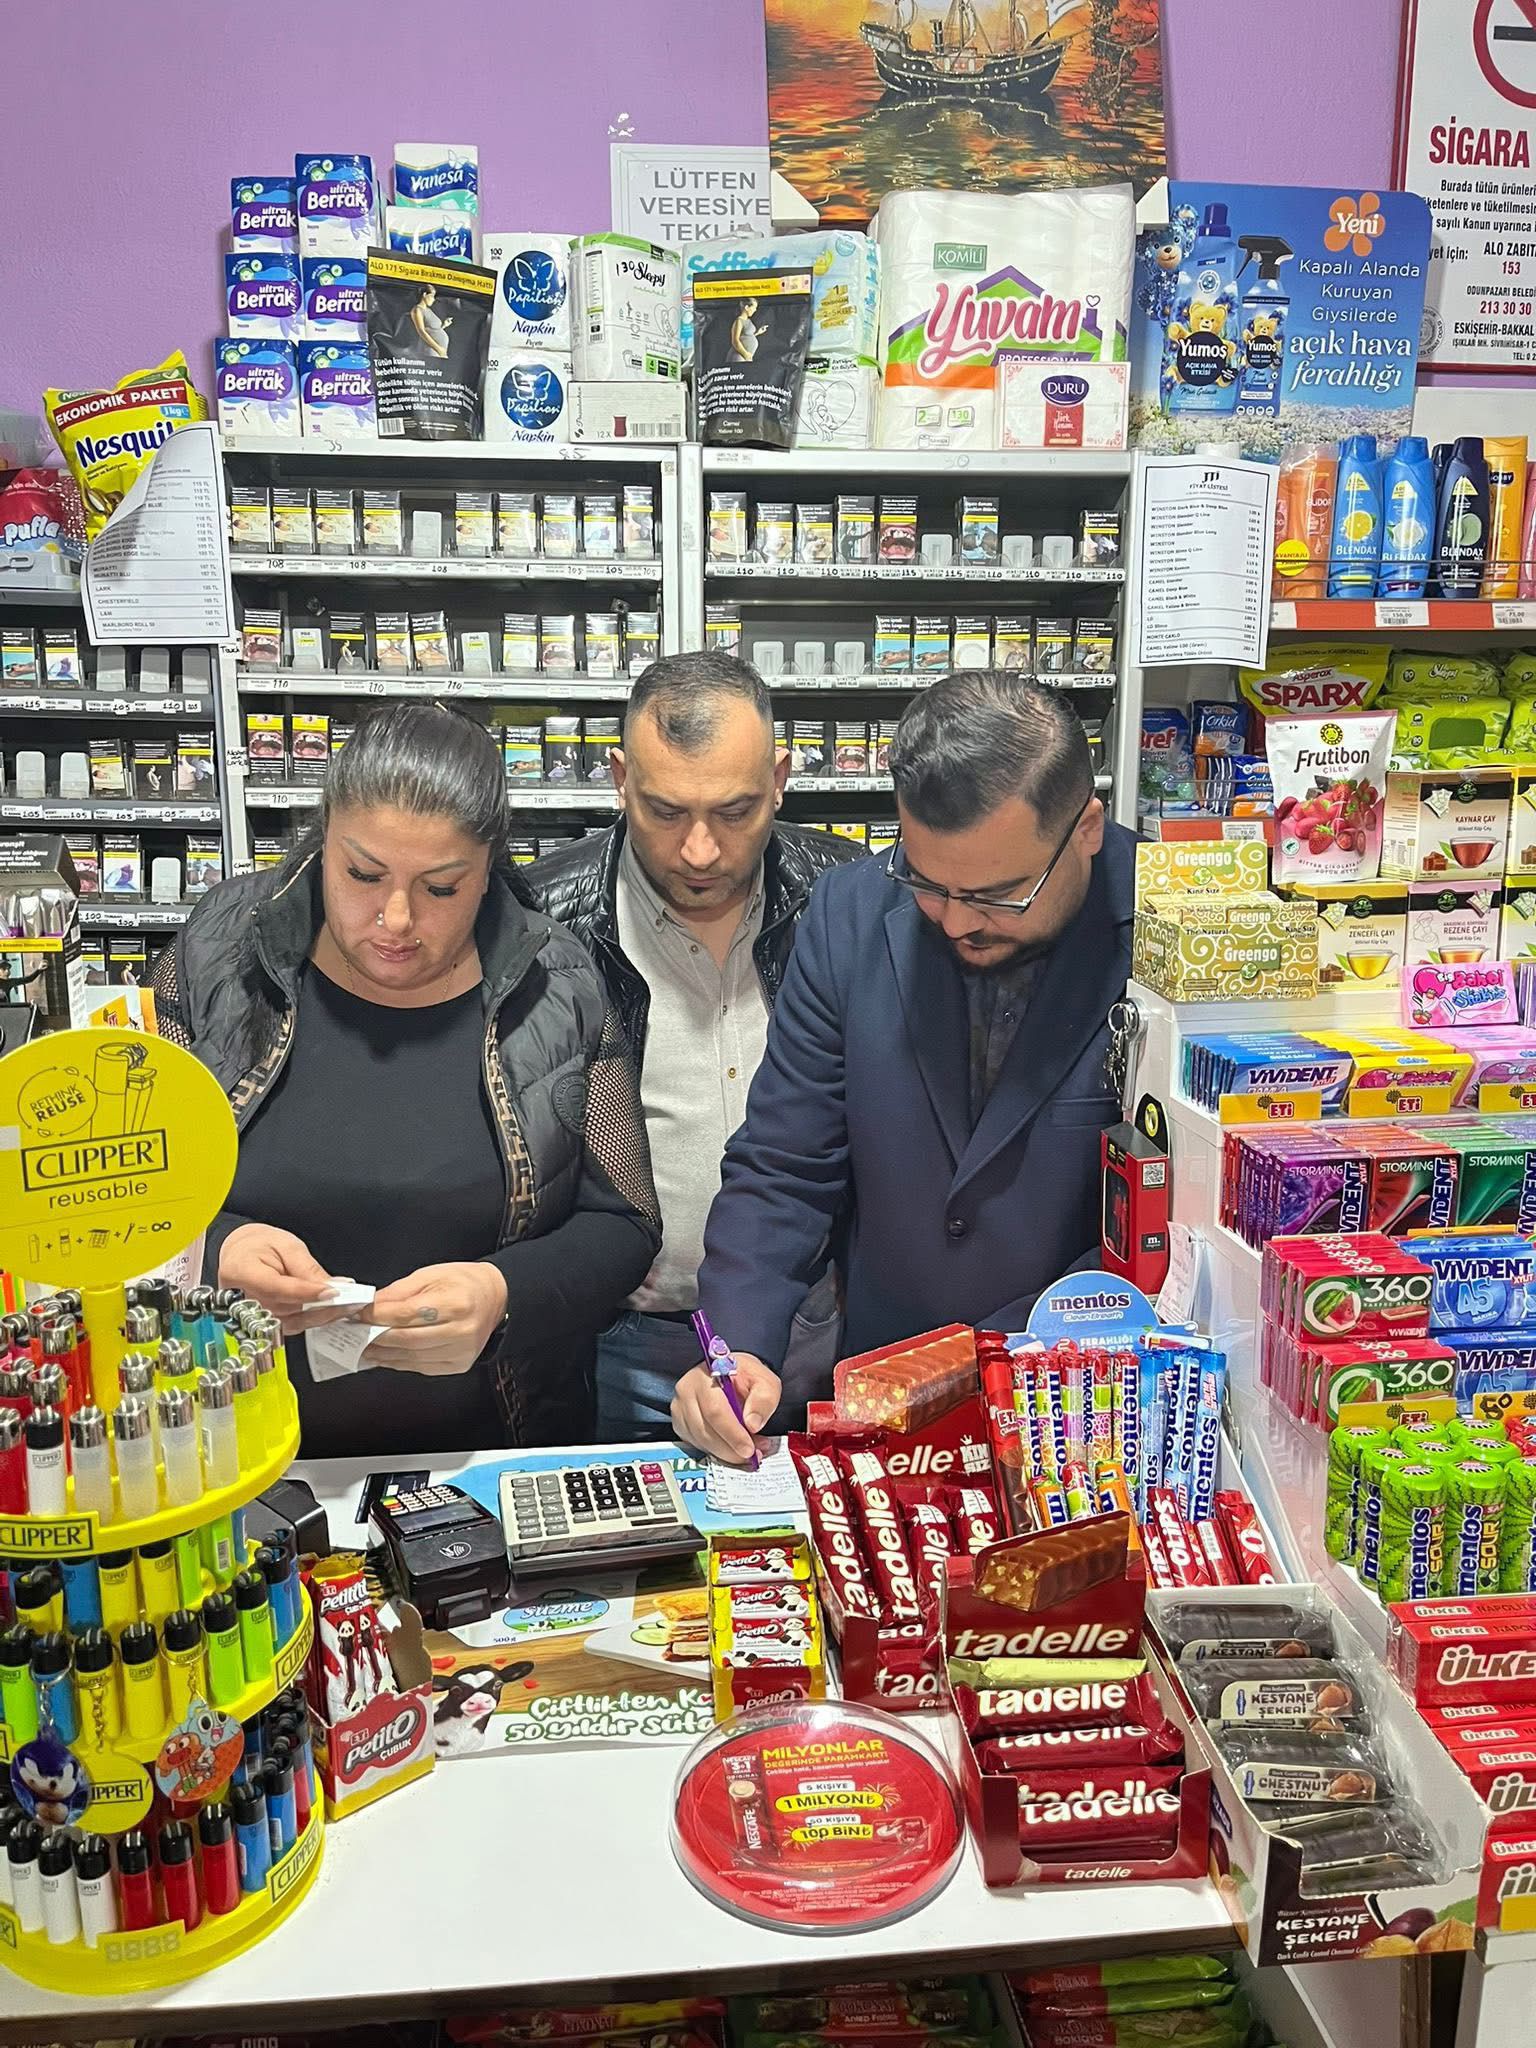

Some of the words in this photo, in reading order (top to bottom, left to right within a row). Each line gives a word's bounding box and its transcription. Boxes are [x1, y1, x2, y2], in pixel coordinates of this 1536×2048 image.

[1429, 116, 1530, 168] SİGARA
[410, 168, 463, 192] Vanesa
[654, 166, 756, 190] LÜTFEN
[1441, 180, 1473, 194] Burada
[1475, 181, 1498, 194] tütün
[307, 191, 366, 211] Berrak
[640, 194, 770, 216] VERESİYE
[1471, 202, 1481, 211] ve
[239, 212, 297, 230] Berrak
[1336, 213, 1380, 236] Yeni
[1436, 219, 1461, 232] sayılı
[1463, 220, 1491, 231] Kanun
[1493, 222, 1532, 234] uyarınca
[937, 247, 984, 265] KOMİLİ
[1446, 246, 1469, 262] için:
[1484, 241, 1504, 255] ALO
[370, 262, 384, 271] ALO
[386, 264, 397, 272] 171
[399, 266, 420, 278] Sigara
[1299, 258, 1353, 277] Kapalı
[1360, 261, 1421, 278] Alanda
[1502, 261, 1521, 275] 153
[237, 291, 295, 310] Berrak
[1322, 284, 1393, 302] Kuruyan
[1312, 307, 1398, 326] Giysilerde
[1480, 301, 1500, 315] 213
[1502, 302, 1516, 315] 30
[1518, 302, 1532, 315] 30
[511, 321, 556, 337] Napkin
[922, 283, 1082, 379] Yuvam
[1290, 330, 1344, 362] açık
[1351, 331, 1412, 356] hava
[224, 374, 285, 392] Berrak
[1289, 362, 1402, 393] ferahlığı
[131, 387, 180, 404] PAKET
[311, 379, 371, 397] Berrak
[1046, 381, 1085, 396] DURU
[1336, 545, 1377, 556] BLENDAX
[1441, 546, 1484, 558] BLENDAX
[1292, 666, 1333, 683] Asperox
[1260, 681, 1368, 709] SPARX
[1206, 714, 1237, 728] Orkid
[1294, 747, 1370, 774] Frutibon
[1322, 764, 1350, 774] ÇİLEK
[271, 794, 288, 804] 110
[1454, 814, 1480, 824] KAYNAR
[1482, 814, 1496, 825] ÇAY
[1174, 849, 1232, 867] Greengo
[1187, 887, 1204, 897] King
[1206, 887, 1220, 896] Size
[1229, 909, 1271, 924] Greengo
[1186, 928, 1199, 936] The
[1201, 927, 1229, 936] Natural
[1285, 925, 1302, 935] King
[1348, 929, 1379, 938] ZENCEFİL
[1443, 926, 1467, 935] REZENE
[1468, 925, 1488, 935] ÇAYI
[1223, 946, 1278, 963] Greengo
[30, 1084, 80, 1112] RETHINK
[36, 1093, 87, 1122] REUSE
[36, 1139, 154, 1180] CLIPPER
[1378, 1160, 1434, 1173] STORMING
[1468, 1155, 1524, 1167] STORMING
[1289, 1164, 1343, 1177] STORMING
[48, 1179, 149, 1209] reusable
[1050, 1292, 1131, 1312] mentos
[1083, 1368, 1094, 1447] mentos
[1025, 1371, 1042, 1479] mentos
[1122, 1364, 1139, 1476] mentos
[1182, 1361, 1201, 1473] mentos
[1194, 1417, 1218, 1520] mentos
[1363, 1485, 1381, 1580] mentos
[821, 1486, 867, 1619] tadelle
[865, 1484, 918, 1619] tadelle
[1412, 1507, 1431, 1600] mentos
[1430, 1520, 1445, 1572] SOUR
[1459, 1505, 1481, 1596] mentos
[1481, 1520, 1499, 1569] SOUR
[1415, 1604, 1472, 1617] ÜLKER
[1431, 1623, 1489, 1637] ÜLKER
[955, 1624, 1129, 1658] tadelle
[280, 1630, 312, 1679] CLIPPER
[1437, 1646, 1536, 1685] ÜLKE
[977, 1684, 1128, 1718] tadelle
[1252, 1692, 1315, 1705] KESTANE
[1258, 1704, 1307, 1719] ŞEKERİ
[507, 1723, 541, 1741] 50
[1459, 1728, 1519, 1742] ÜLKER
[762, 1739, 885, 1760] MİLYONLAR
[764, 1757, 823, 1769] DEĞERİNDE
[816, 1782, 849, 1792] KİŞİYE
[1259, 1778, 1330, 1793] CHESTNUT
[1272, 1788, 1315, 1801] CANDY
[1023, 1791, 1181, 1825] tadelle
[276, 1840, 322, 1890] CLIPPER
[1064, 1866, 1131, 1880] tadelle
[1276, 1913, 1370, 1931] KESTANE
[1284, 1926, 1359, 1949] ŞEKERİ
